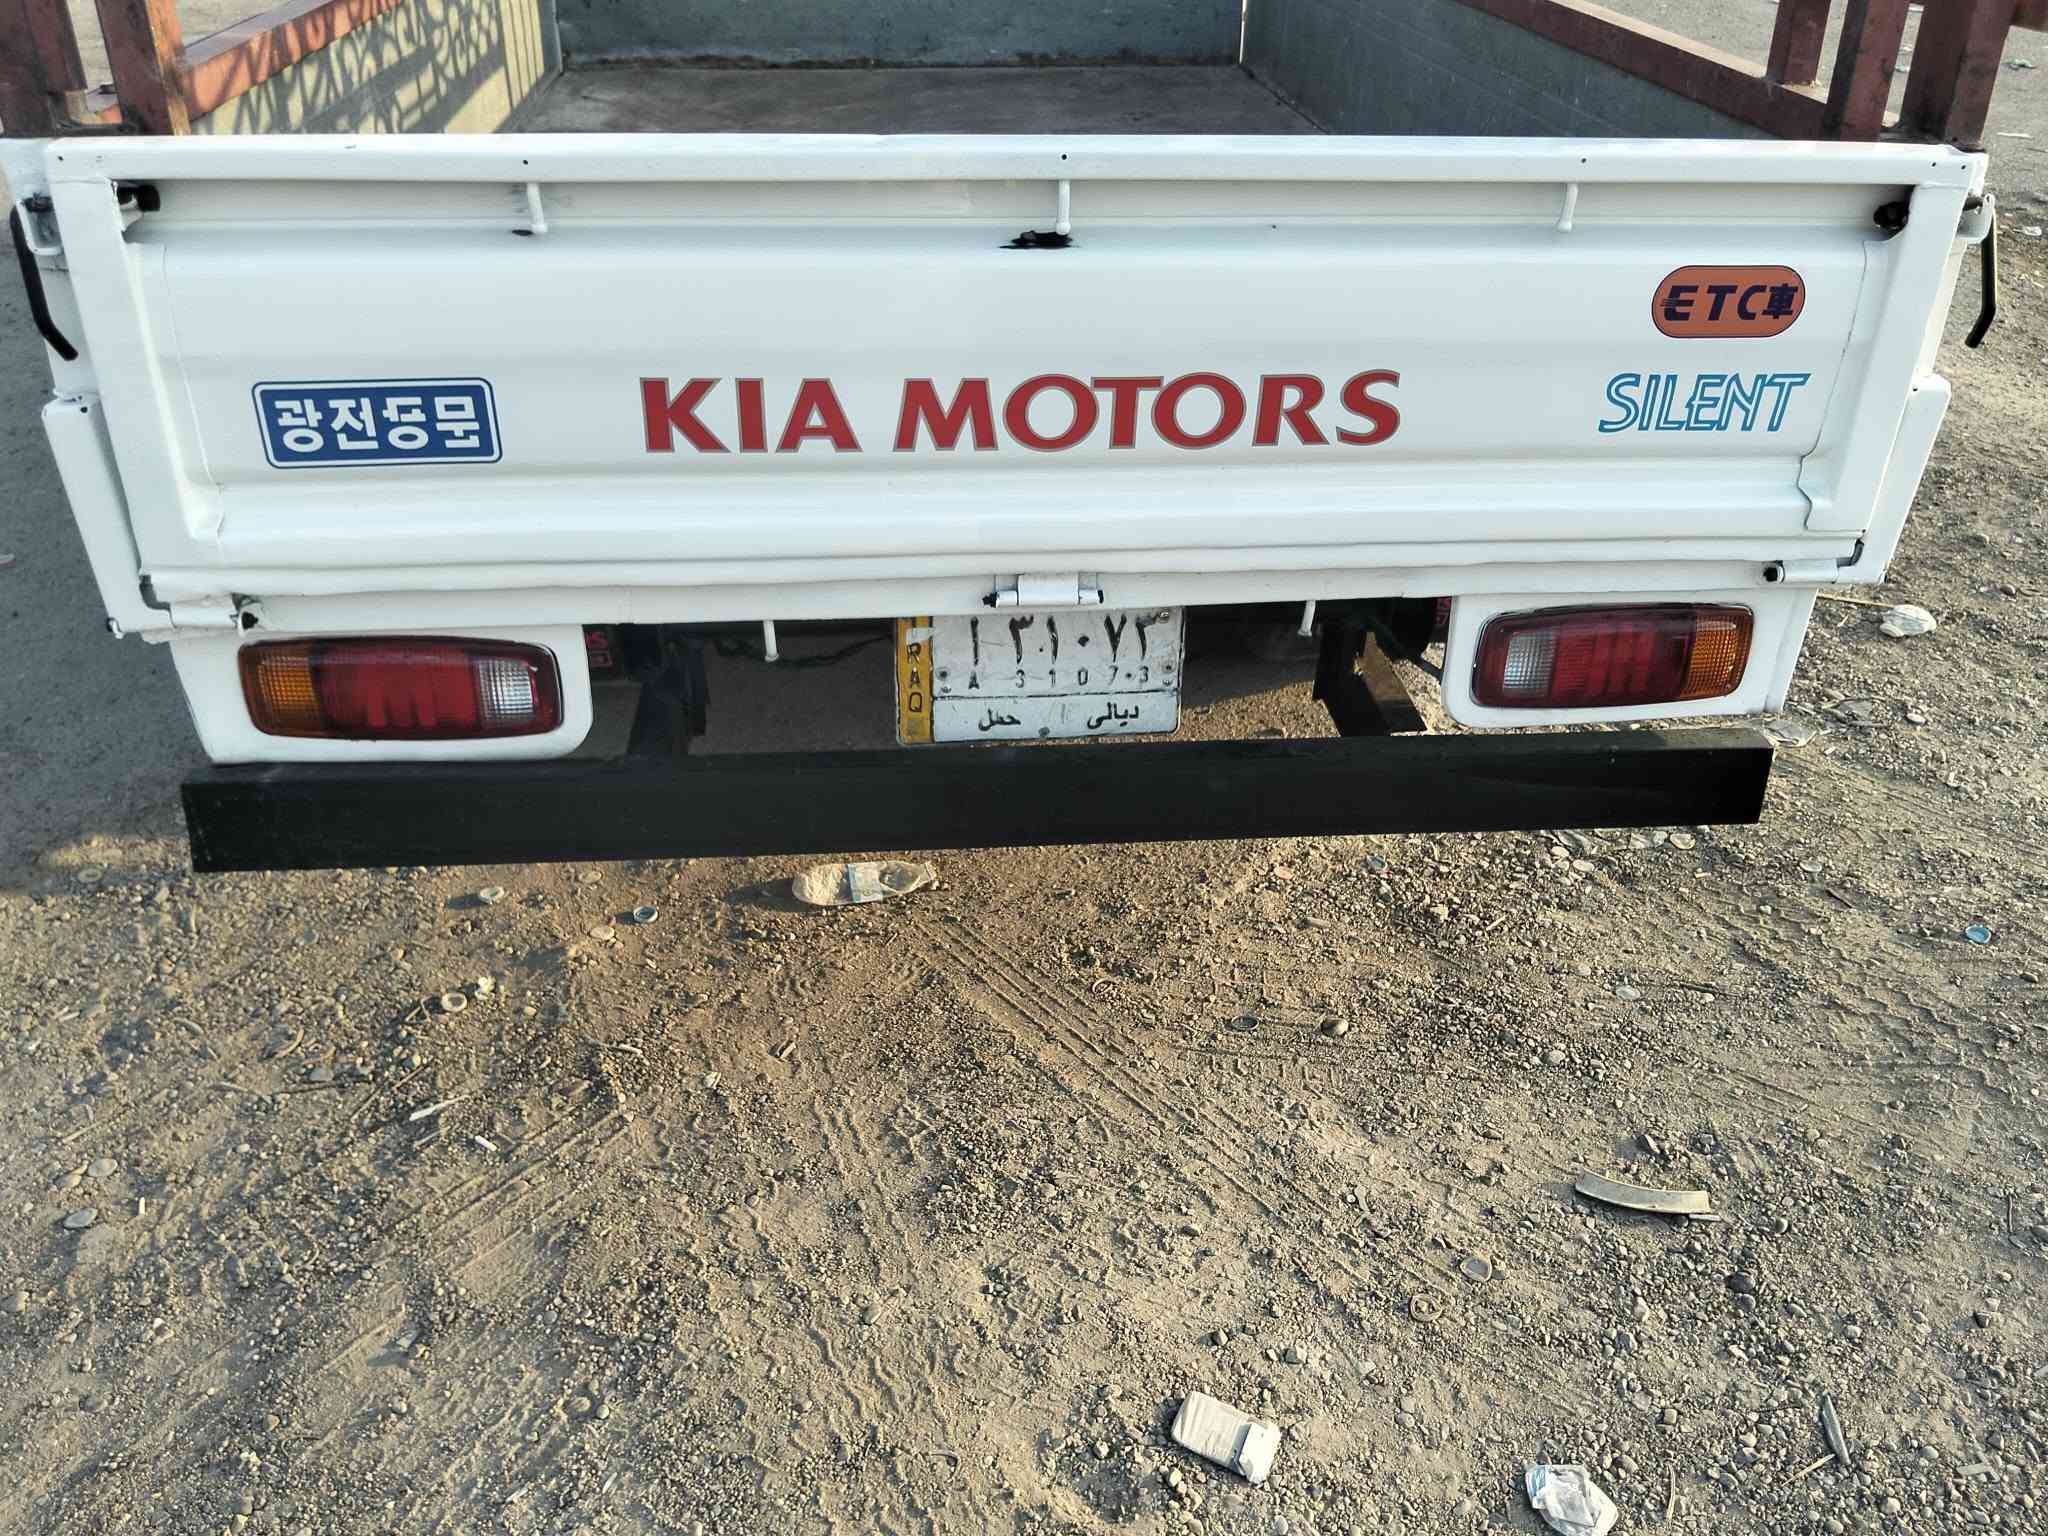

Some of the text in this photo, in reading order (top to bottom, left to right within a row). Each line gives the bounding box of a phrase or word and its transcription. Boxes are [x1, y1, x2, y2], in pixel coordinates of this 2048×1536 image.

[640, 369, 1400, 453] KIA MOTORS
[1598, 372, 1811, 433] SILENT
